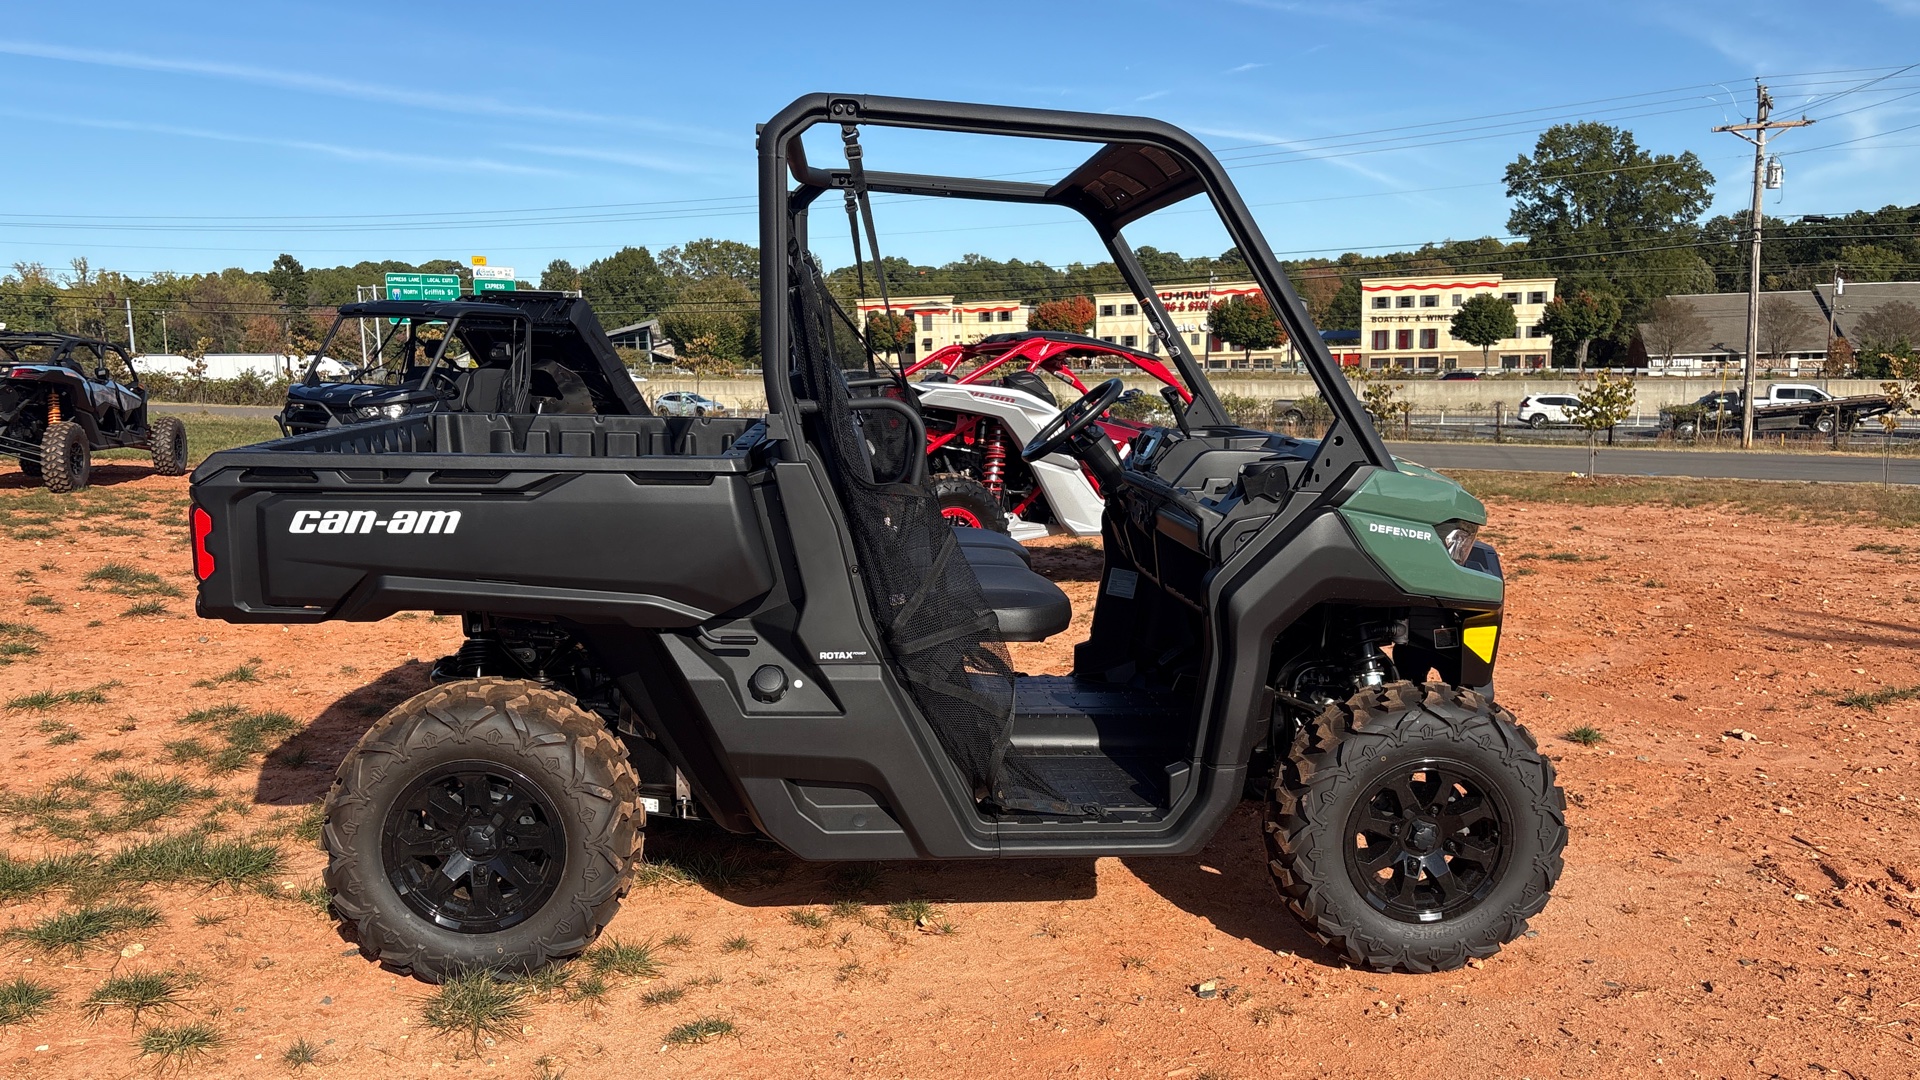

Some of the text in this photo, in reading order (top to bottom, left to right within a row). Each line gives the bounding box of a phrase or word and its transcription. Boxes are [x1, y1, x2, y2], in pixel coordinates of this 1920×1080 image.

[485, 282, 505, 290] EXPRESS
[1371, 314, 1449, 324] BOAT RV & WINE
[288, 510, 462, 534] can-am
[1369, 523, 1432, 541] DEFENDER
[820, 651, 853, 660] ROTAX
